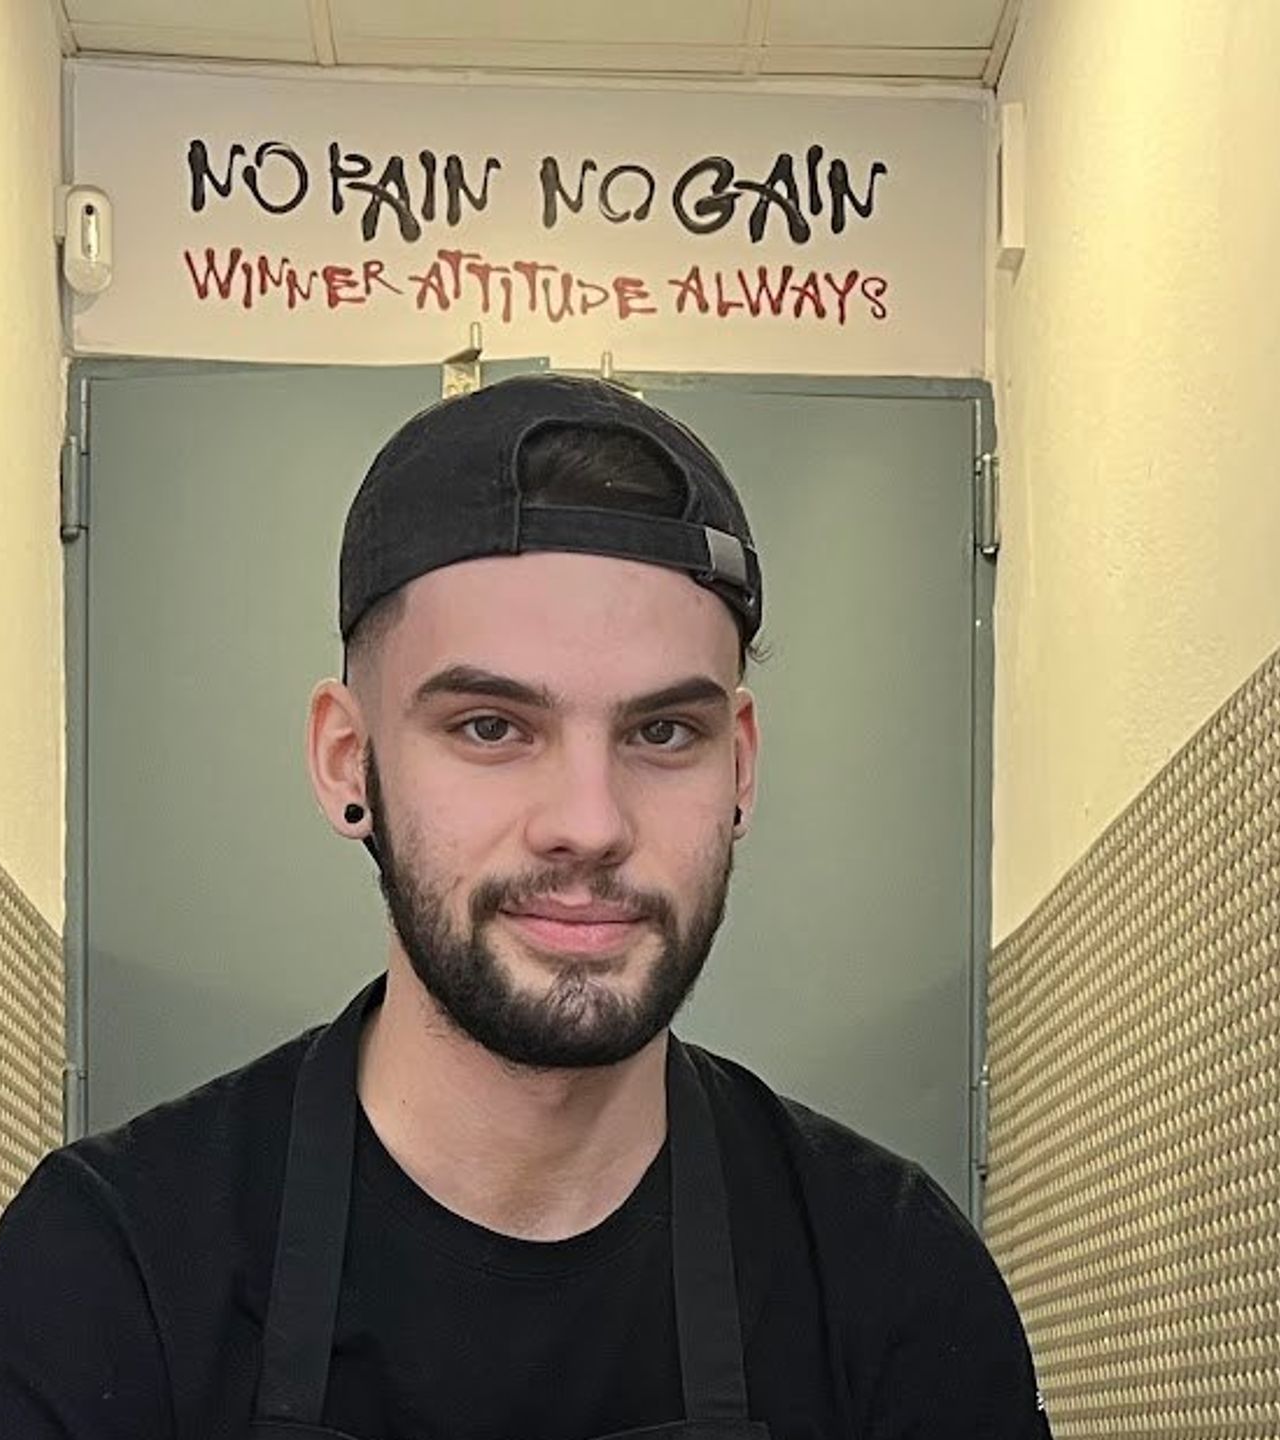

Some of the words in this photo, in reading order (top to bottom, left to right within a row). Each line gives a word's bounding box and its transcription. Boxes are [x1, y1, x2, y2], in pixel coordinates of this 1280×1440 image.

[187, 139, 308, 214] NO
[329, 142, 501, 243] PAIN
[540, 155, 655, 229] NO
[672, 143, 888, 244] GAIN
[183, 246, 406, 310] WINNER
[408, 248, 658, 324] ATTITUDE
[668, 264, 889, 326] ALWAYS
